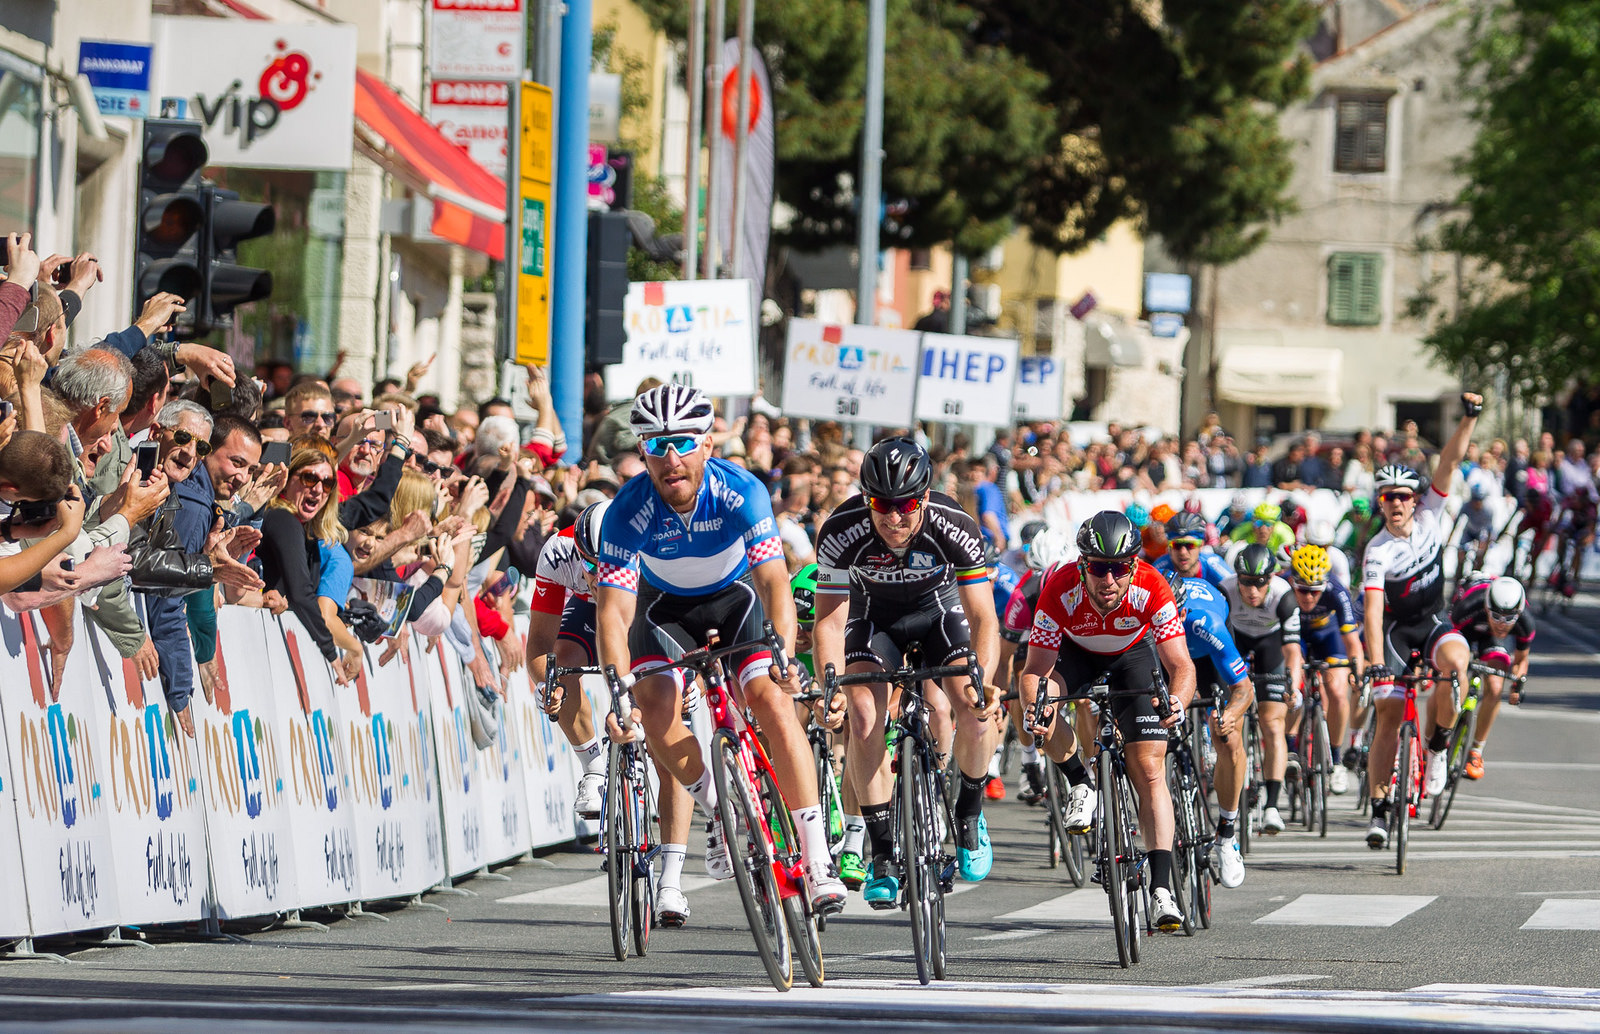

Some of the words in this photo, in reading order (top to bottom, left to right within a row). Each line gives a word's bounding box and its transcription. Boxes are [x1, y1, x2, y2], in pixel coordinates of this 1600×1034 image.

[95, 95, 127, 111] STE
[195, 79, 282, 145] vip
[622, 304, 747, 333] ROATIA
[1020, 357, 1056, 385] EP
[817, 517, 871, 567] Willems
[544, 544, 581, 571] IAM
